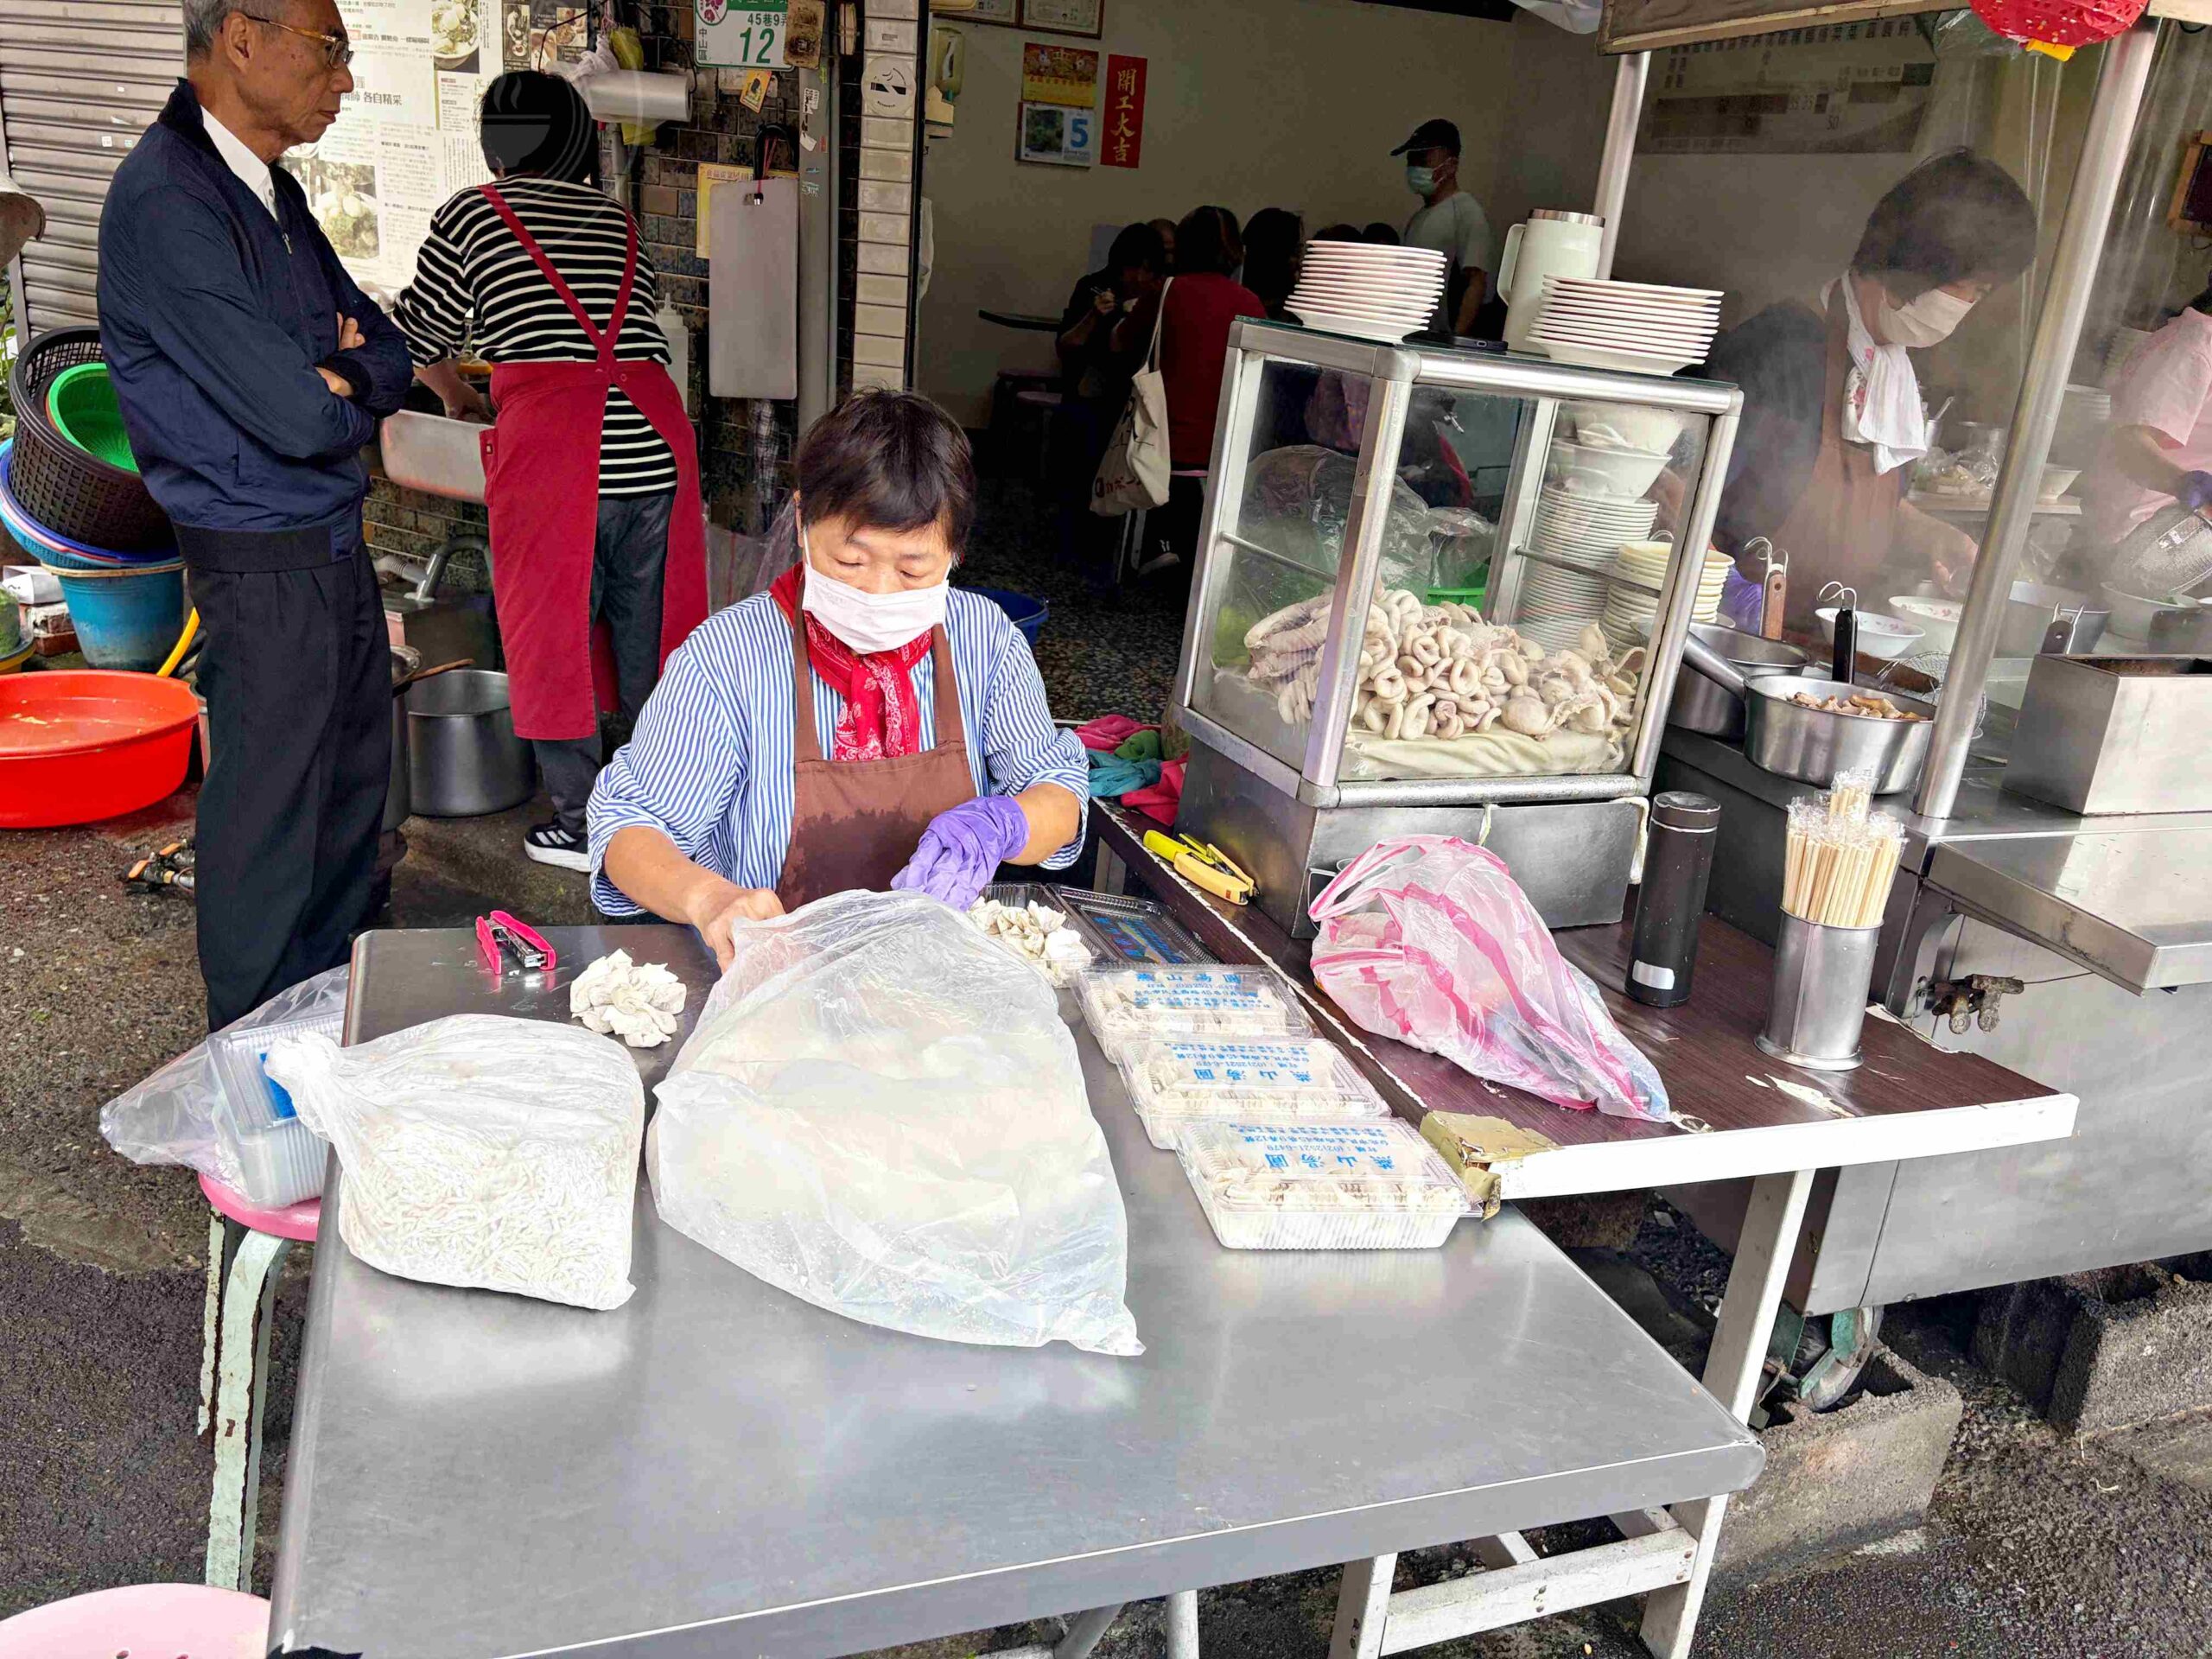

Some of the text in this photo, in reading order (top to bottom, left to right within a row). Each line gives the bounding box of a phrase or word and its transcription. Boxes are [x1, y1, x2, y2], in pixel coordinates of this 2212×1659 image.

[698, 28, 708, 61] 中山區
[740, 27, 775, 64] 12
[363, 92, 403, 106] 各自精采
[1109, 68, 1138, 162] 開工大吉
[1070, 118, 1089, 149] 5
[1193, 1068, 1313, 1084] 燕山湯圓
[1264, 1153, 1396, 1171] 燕山湯圓
